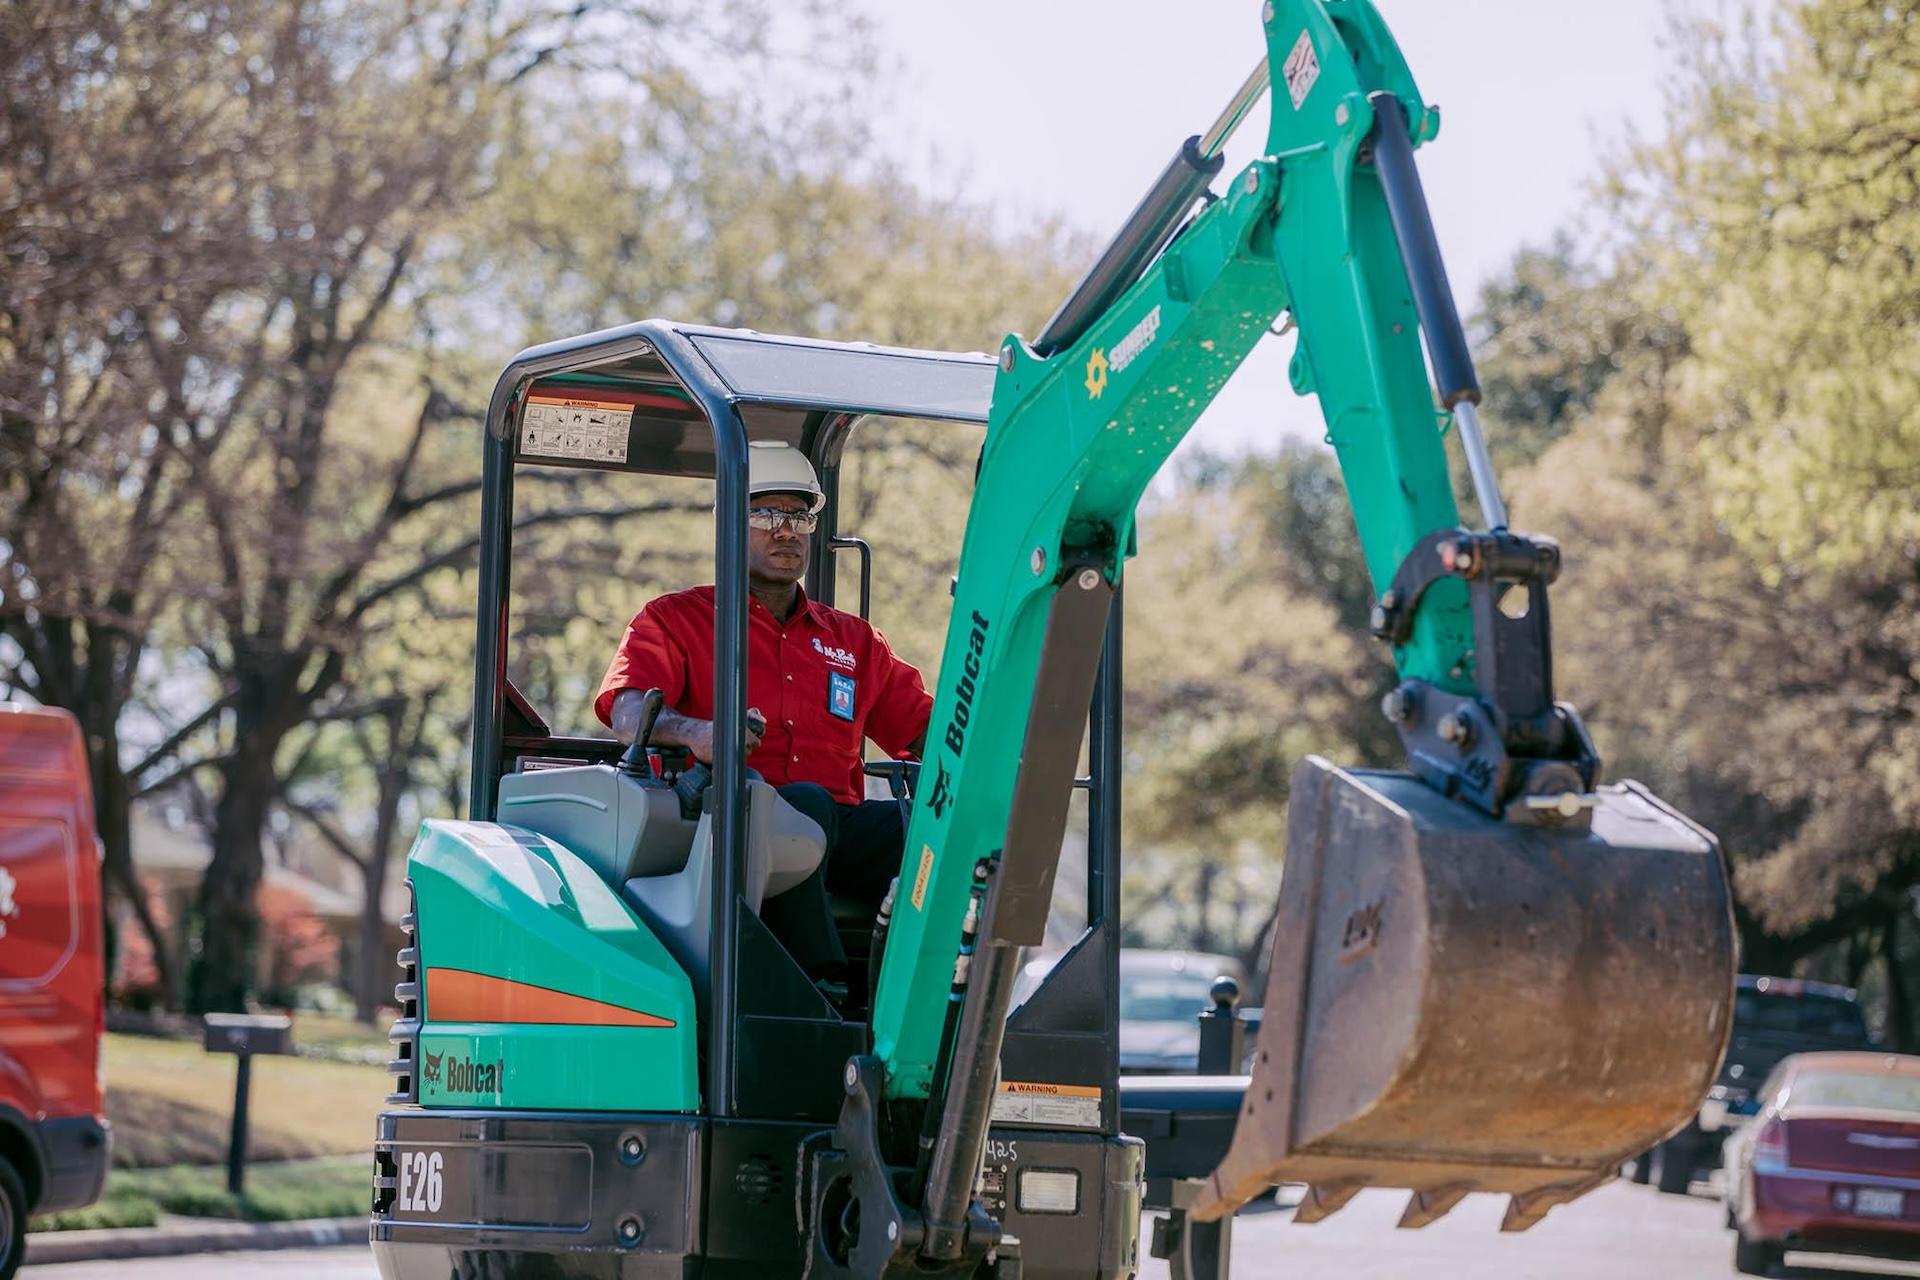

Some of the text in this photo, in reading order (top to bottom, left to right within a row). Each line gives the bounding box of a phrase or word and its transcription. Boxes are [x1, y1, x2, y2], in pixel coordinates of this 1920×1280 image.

[945, 609, 989, 758] Bobcat
[447, 1056, 504, 1094] Bobcat
[1018, 1084, 1058, 1094] WARNING
[400, 1151, 444, 1213] E26
